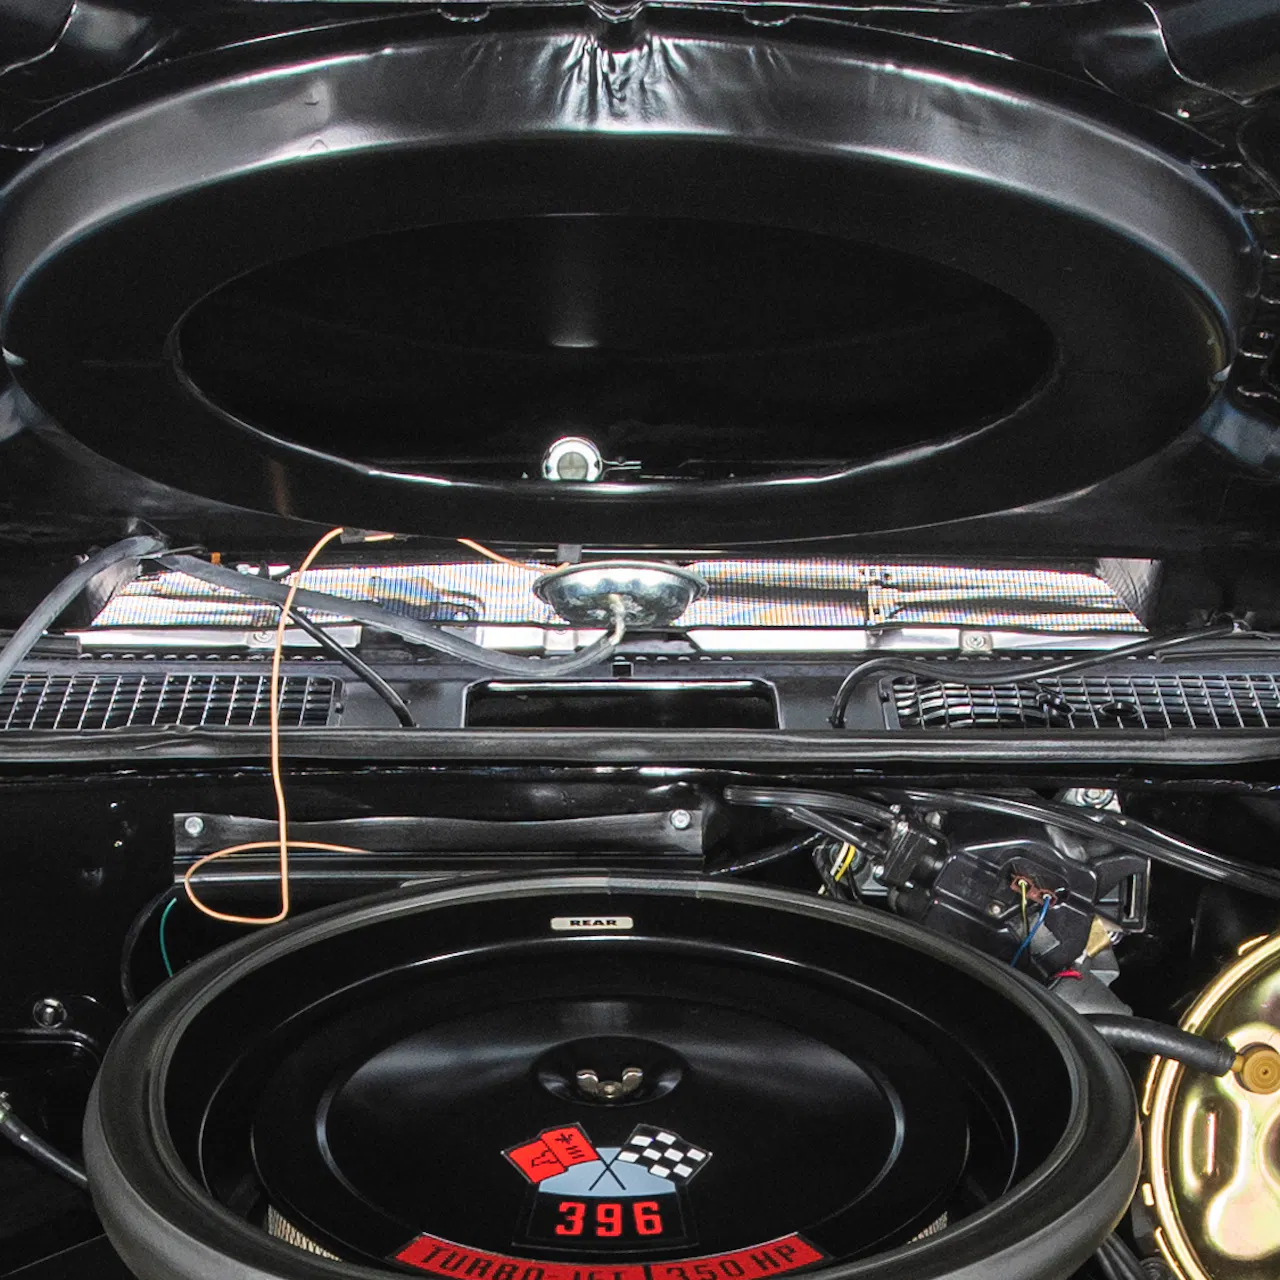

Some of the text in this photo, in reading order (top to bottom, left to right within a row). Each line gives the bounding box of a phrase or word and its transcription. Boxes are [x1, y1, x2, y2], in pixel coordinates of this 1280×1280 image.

[569, 919, 617, 927] REAR
[554, 1200, 664, 1238] 396
[751, 1243, 798, 1275] HP
